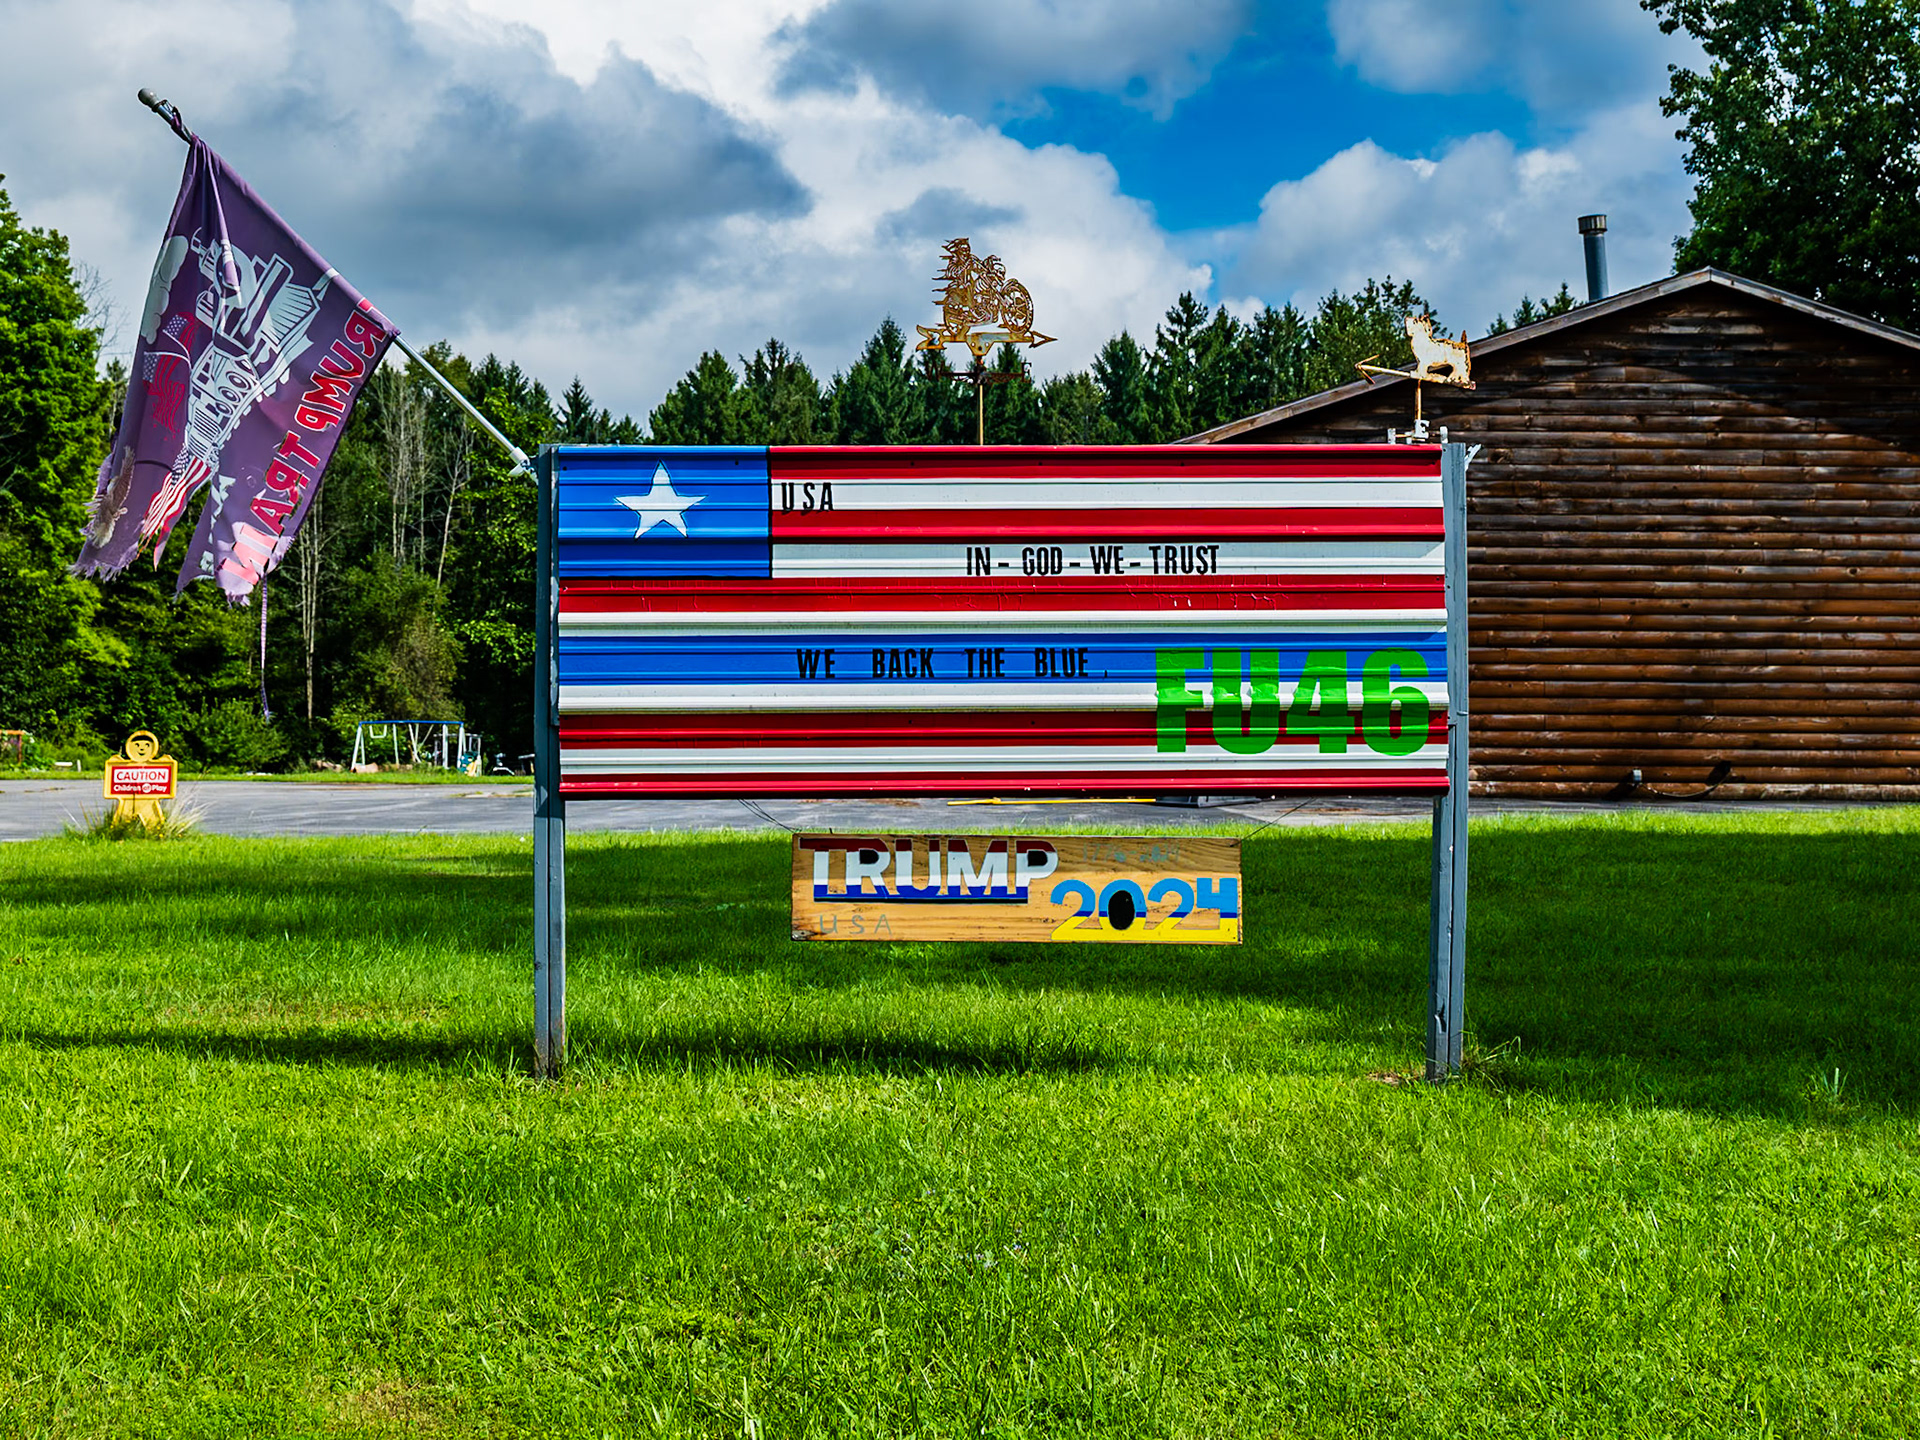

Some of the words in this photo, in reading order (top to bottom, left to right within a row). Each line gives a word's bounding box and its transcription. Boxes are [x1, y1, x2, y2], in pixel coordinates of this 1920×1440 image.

[781, 482, 834, 512] USA
[1149, 545, 1220, 576] TRUST
[796, 648, 836, 679] WE
[872, 648, 935, 678] BACK
[963, 648, 1005, 678] THE
[1034, 647, 1089, 677] BLUE
[1155, 647, 1430, 756] FU46
[113, 784, 141, 792] Children
[151, 784, 167, 793] Play
[116, 771, 166, 781] CAUTION
[799, 838, 1059, 899] TRUMP
[820, 914, 892, 935] USA
[1050, 877, 1239, 942] 2024
